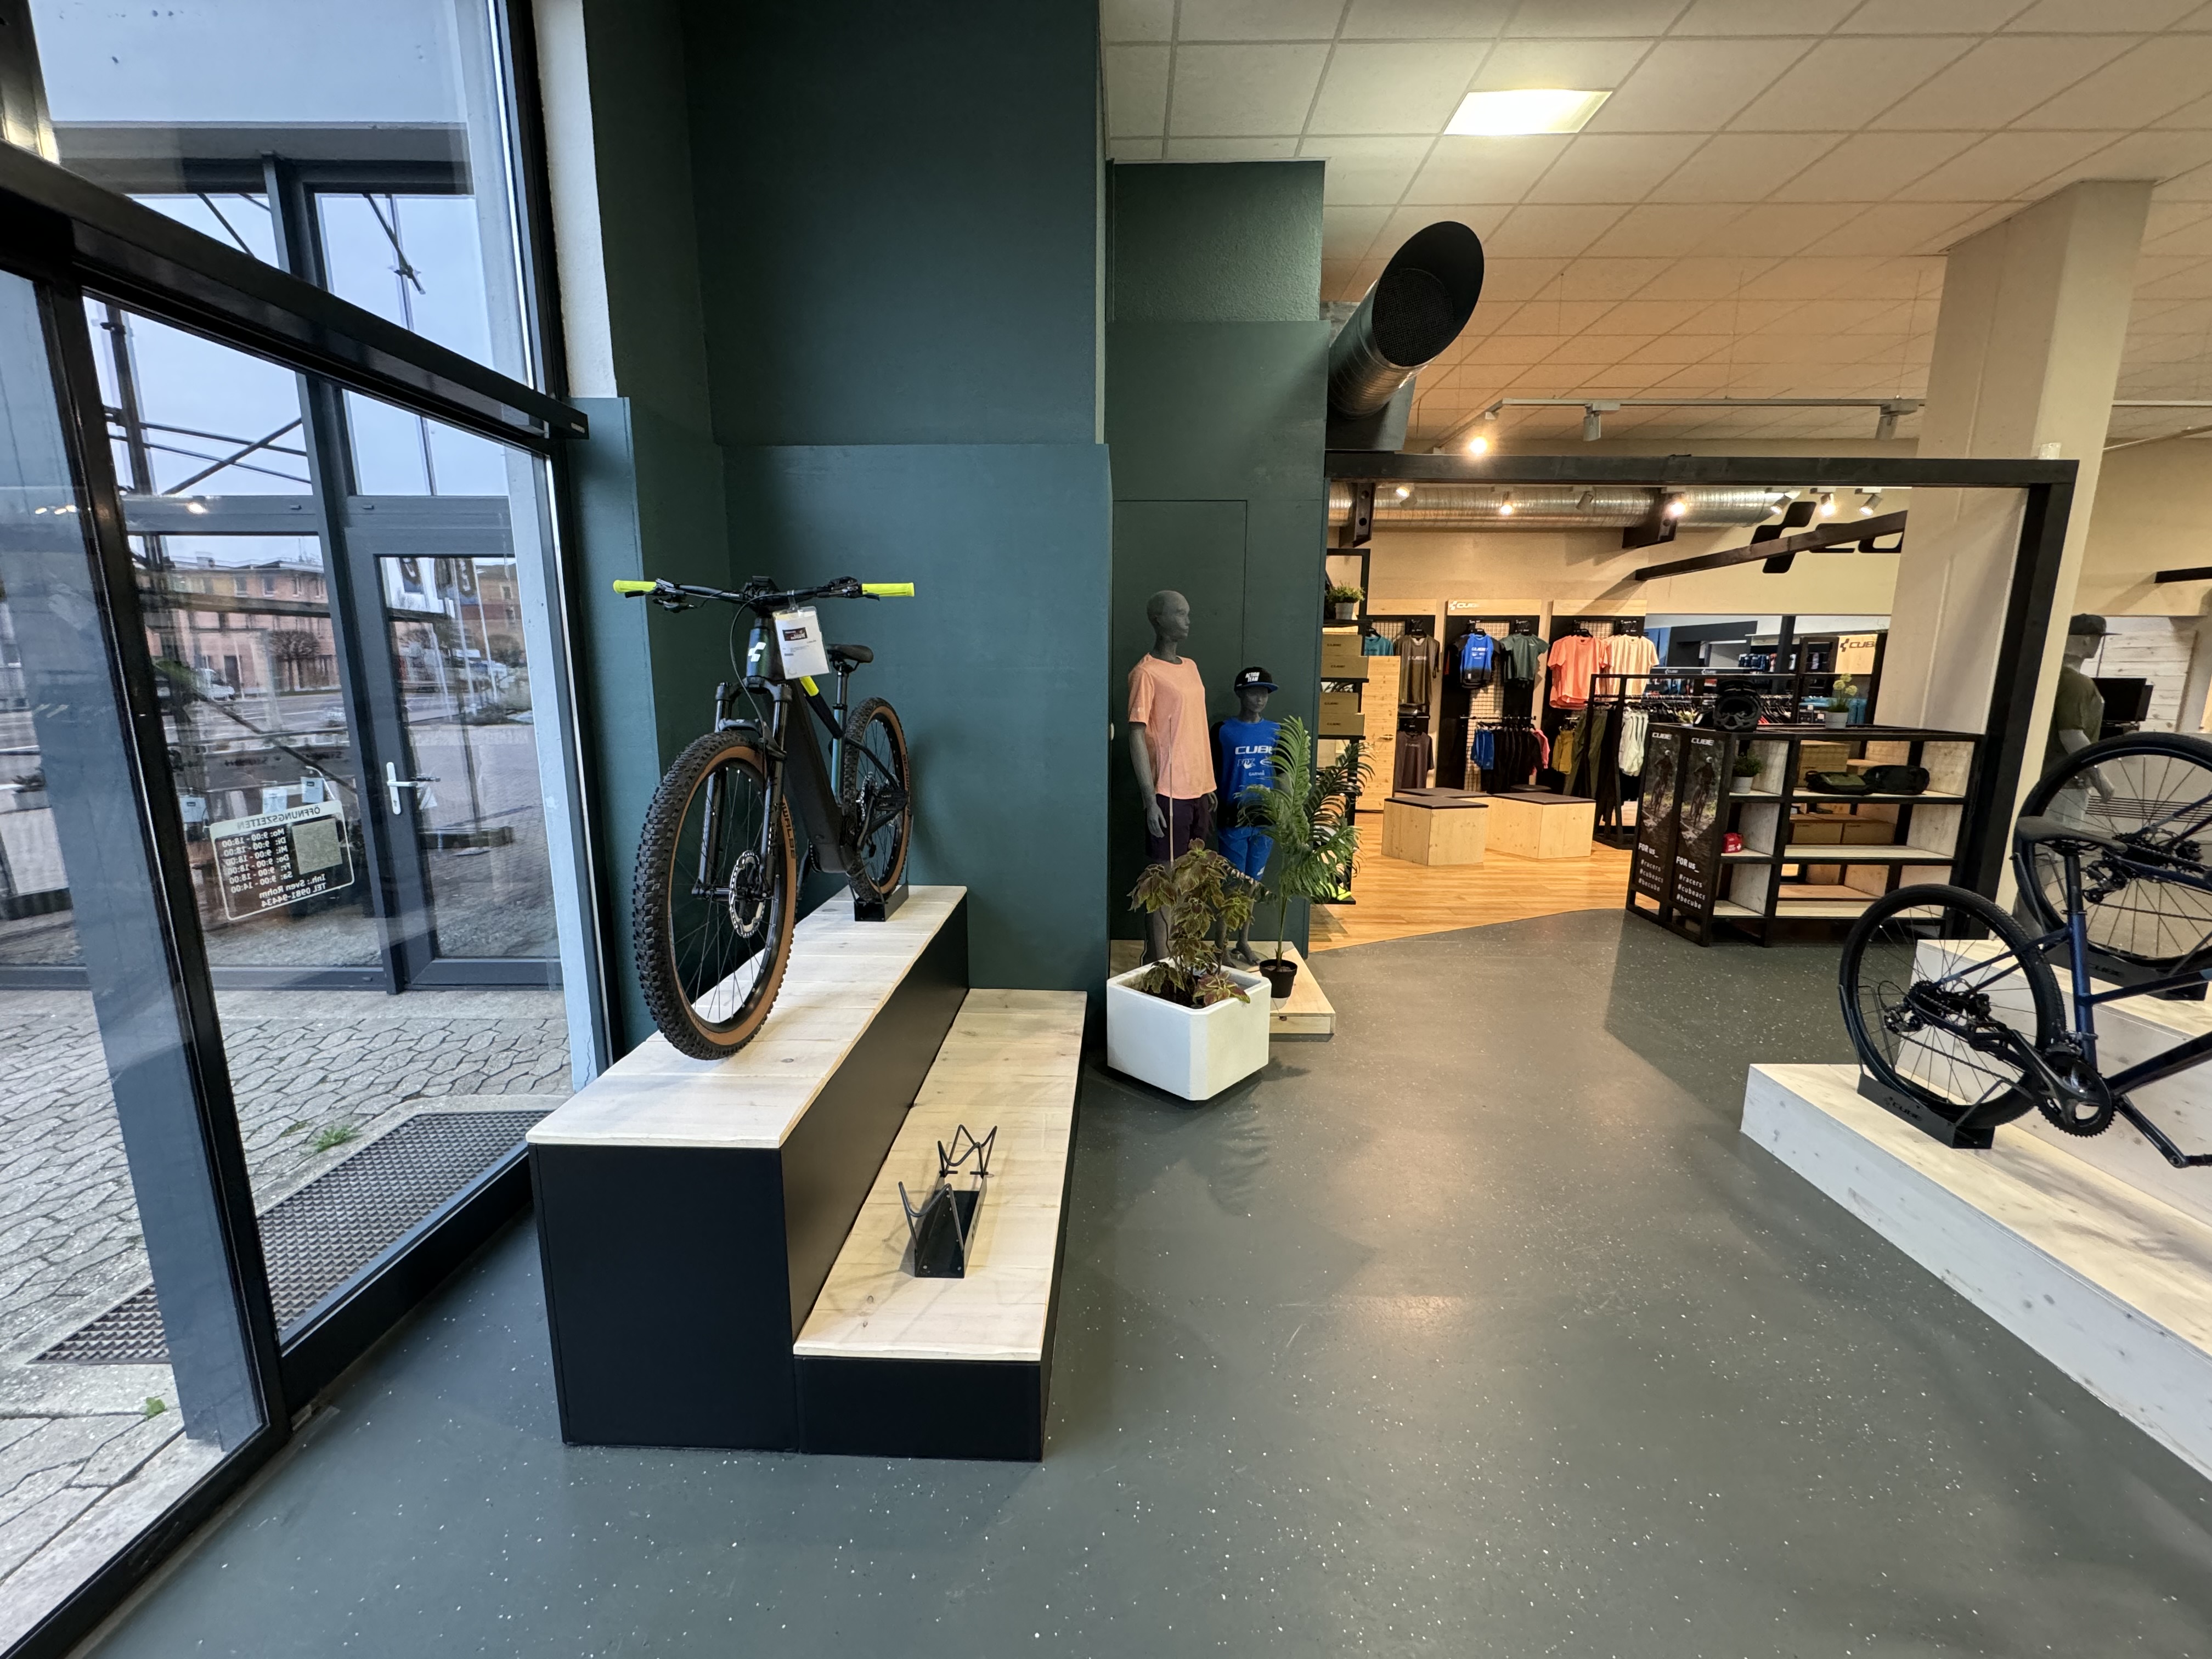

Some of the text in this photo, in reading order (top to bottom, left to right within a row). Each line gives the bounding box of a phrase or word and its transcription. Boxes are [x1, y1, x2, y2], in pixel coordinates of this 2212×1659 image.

[1691, 738, 1714, 746] CUBE
[1638, 843, 1649, 853] FOR
[1640, 859, 1661, 872] #racers
[1676, 856, 1688, 867] FOR
[1640, 868, 1663, 883] #cubeacs
[1679, 873, 1702, 888] #racers
[1638, 878, 1660, 891] #becube
[1678, 884, 1706, 900] #cubeacs
[1677, 894, 1701, 910] #becube
